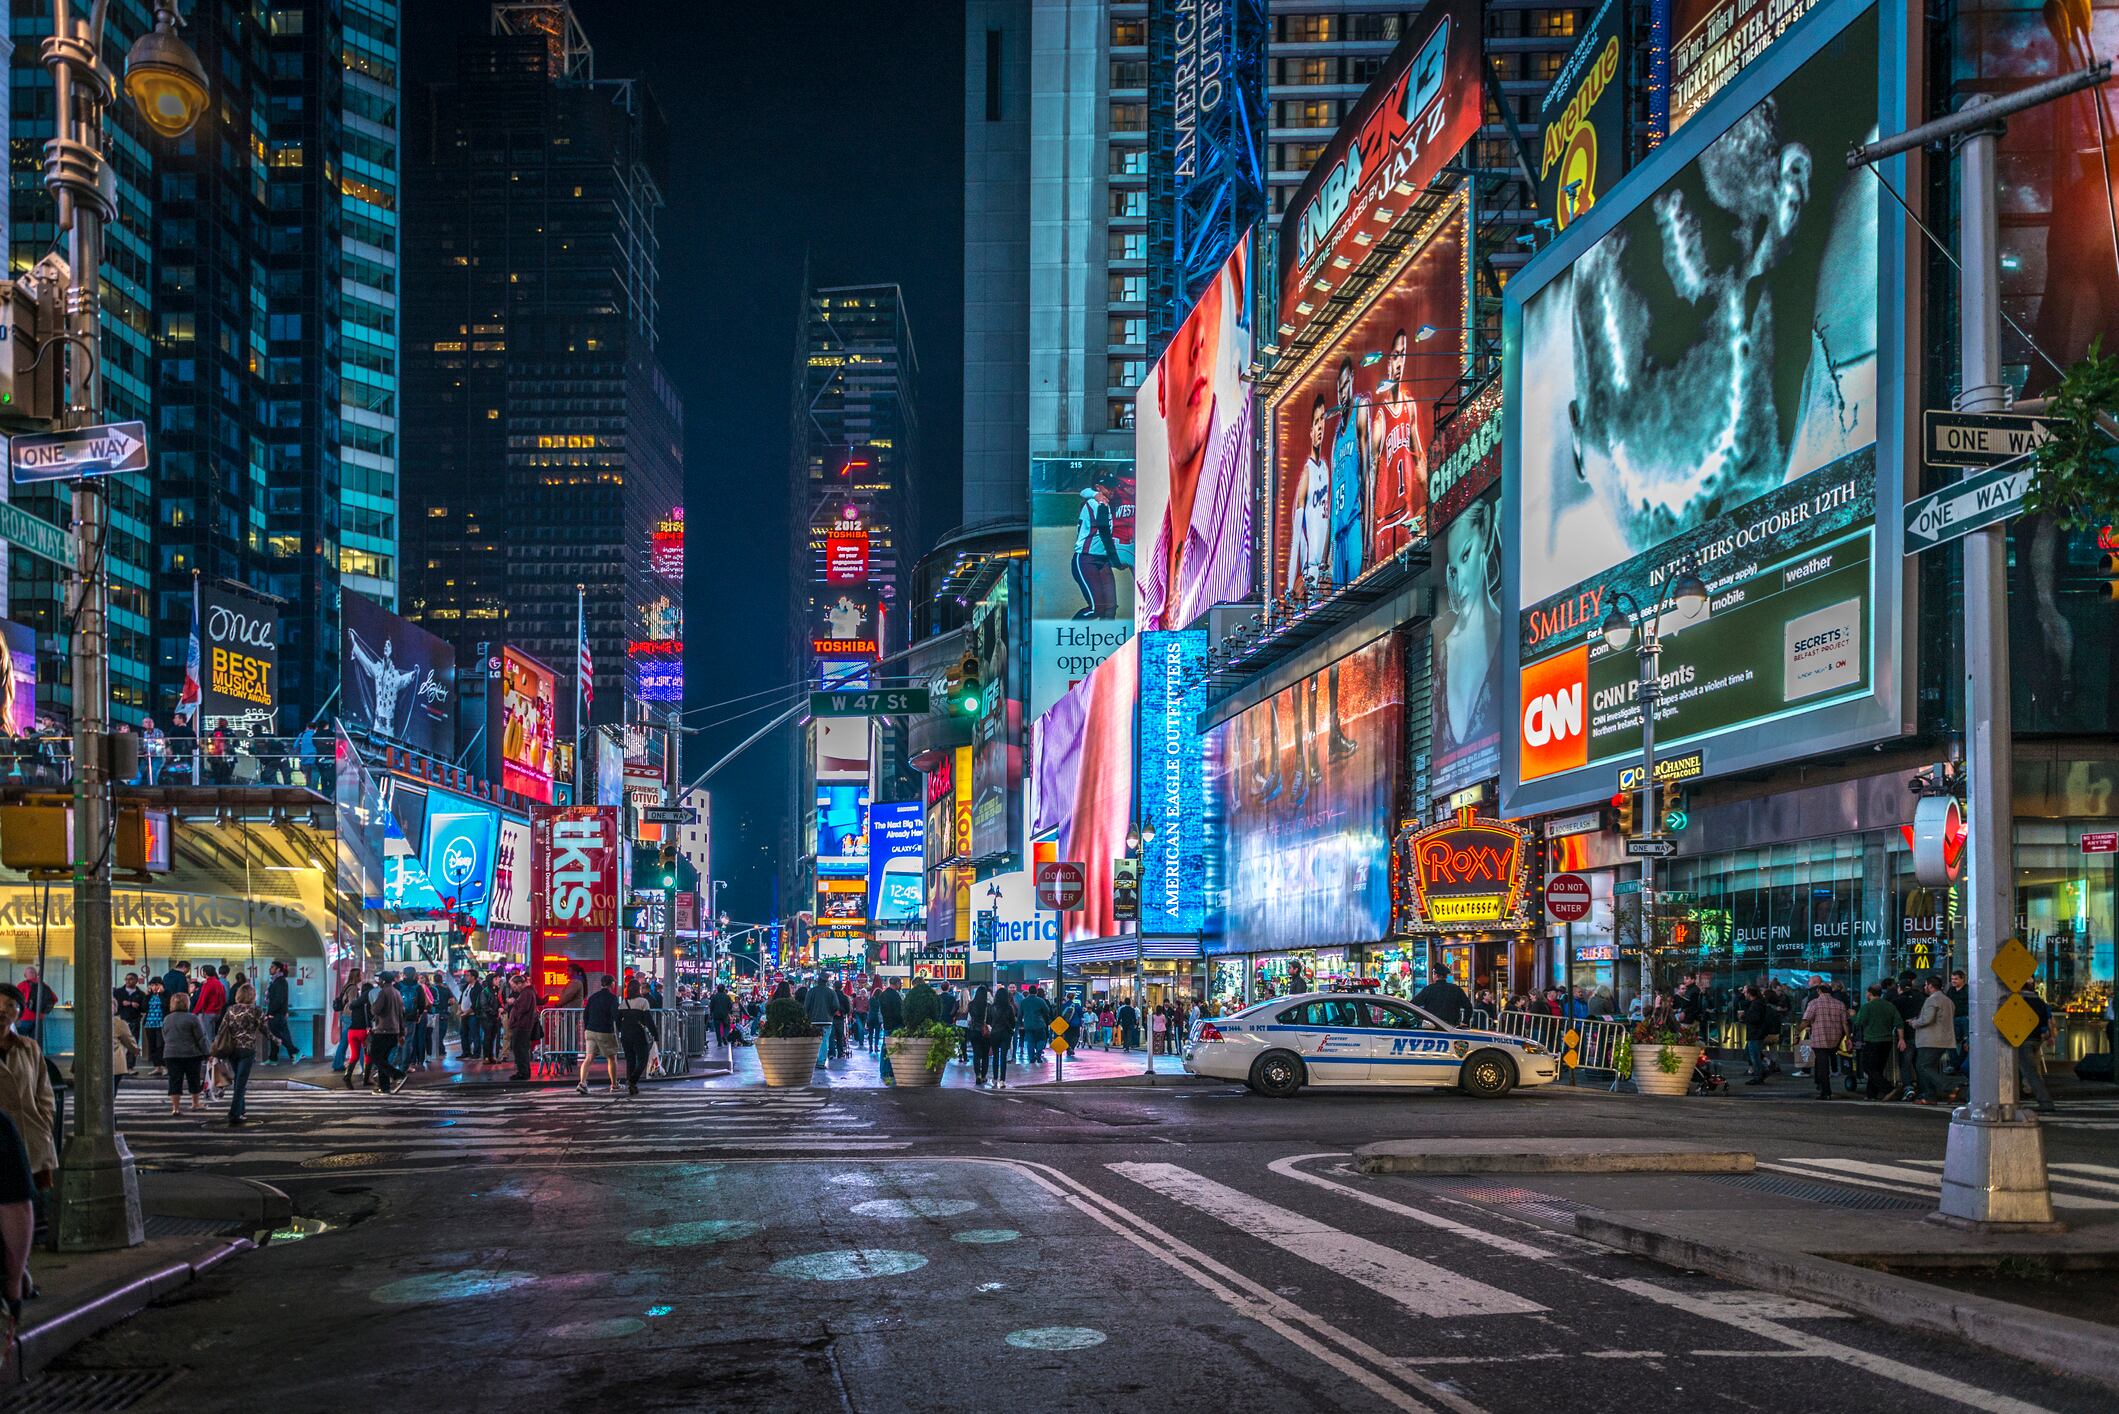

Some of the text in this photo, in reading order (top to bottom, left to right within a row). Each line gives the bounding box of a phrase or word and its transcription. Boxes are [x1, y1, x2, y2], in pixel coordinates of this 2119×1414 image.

[1708, 59, 1740, 98] MARQUIS
[1541, 35, 1619, 181] Avenue
[1306, 16, 1450, 258] NBA 2K13
[1298, 97, 1447, 293] EXECUTIVE PRODUCED BY JAY Z
[1947, 429, 2050, 453] ONE WAY
[24, 438, 129, 466] ONE WAY
[1430, 408, 1502, 504] CHICAGO
[1070, 461, 1083, 469] 215
[1396, 459, 1405, 497] 1
[1115, 504, 1136, 518] WEST
[1919, 503, 1954, 533] ONE
[1976, 477, 2017, 511] WAY
[828, 531, 868, 539] TOSHIBA
[835, 521, 862, 531] 2012
[1650, 563, 1665, 587] IN
[1736, 502, 1811, 549] OCTOBER
[1813, 480, 1857, 514] 12TH
[1718, 573, 1735, 588] may
[1734, 562, 1758, 582] apply)
[1786, 554, 1832, 583] weather
[1711, 589, 1745, 612] mobile
[1528, 585, 1605, 644] SMILEY
[209, 605, 275, 650] once
[813, 641, 876, 652] TOSHIBA
[1056, 626, 1127, 653] Helped
[1794, 629, 1841, 653] SECRETS
[1589, 643, 1609, 658] .com
[1793, 639, 1850, 662] BELFAST PROJECT
[212, 647, 272, 684] BEST
[212, 671, 272, 698] MUSICAL
[1592, 664, 1696, 711] CNN Pents
[213, 684, 272, 706] 2012 TONY AWARD
[832, 694, 908, 711] W 47 St
[1592, 716, 1606, 727] CNN
[1606, 705, 1641, 723] investigates
[1660, 693, 1679, 707] tapes
[1679, 687, 1698, 700] about
[1704, 677, 1728, 692] violent
[1728, 673, 1745, 685] time
[1745, 669, 1754, 680] in
[1524, 682, 1583, 747] CNN
[1592, 706, 1679, 738] Northern Ireland, 8pm.
[623, 784, 659, 793] EXPERIENCE
[1165, 642, 1181, 919] AMERICAN EAGLE OUTFITTERS
[874, 821, 887, 830] The
[887, 820, 902, 829] Next
[902, 819, 914, 830] Big
[886, 830, 911, 840] Already
[2093, 833, 2117, 841] STANDING
[892, 845, 912, 853] GALAXY
[1633, 844, 1671, 852] ONE WAY
[553, 816, 604, 920] tkts
[1045, 872, 1076, 880] DO NOT
[890, 885, 918, 899] 12:45
[1047, 893, 1075, 901] ENTER
[1553, 883, 1583, 892] DO NOT
[1434, 899, 1500, 918] DELICATESSEN
[1555, 904, 1582, 913] ENTER
[1737, 926, 1791, 940] BLUE FIN
[1814, 921, 1876, 938] BLUE FIN
[1903, 916, 1944, 932] BLUE
[488, 928, 528, 954] FOREVER
[1776, 943, 1805, 951] OYSTERS
[1876, 939, 1891, 947] BAR
[1906, 937, 1938, 946] BRUNCH
[299, 966, 314, 979] 12
[932, 964, 962, 979] EVITA
[1390, 1038, 1450, 1056] NYPD
[1493, 1037, 1514, 1045] POLICE
